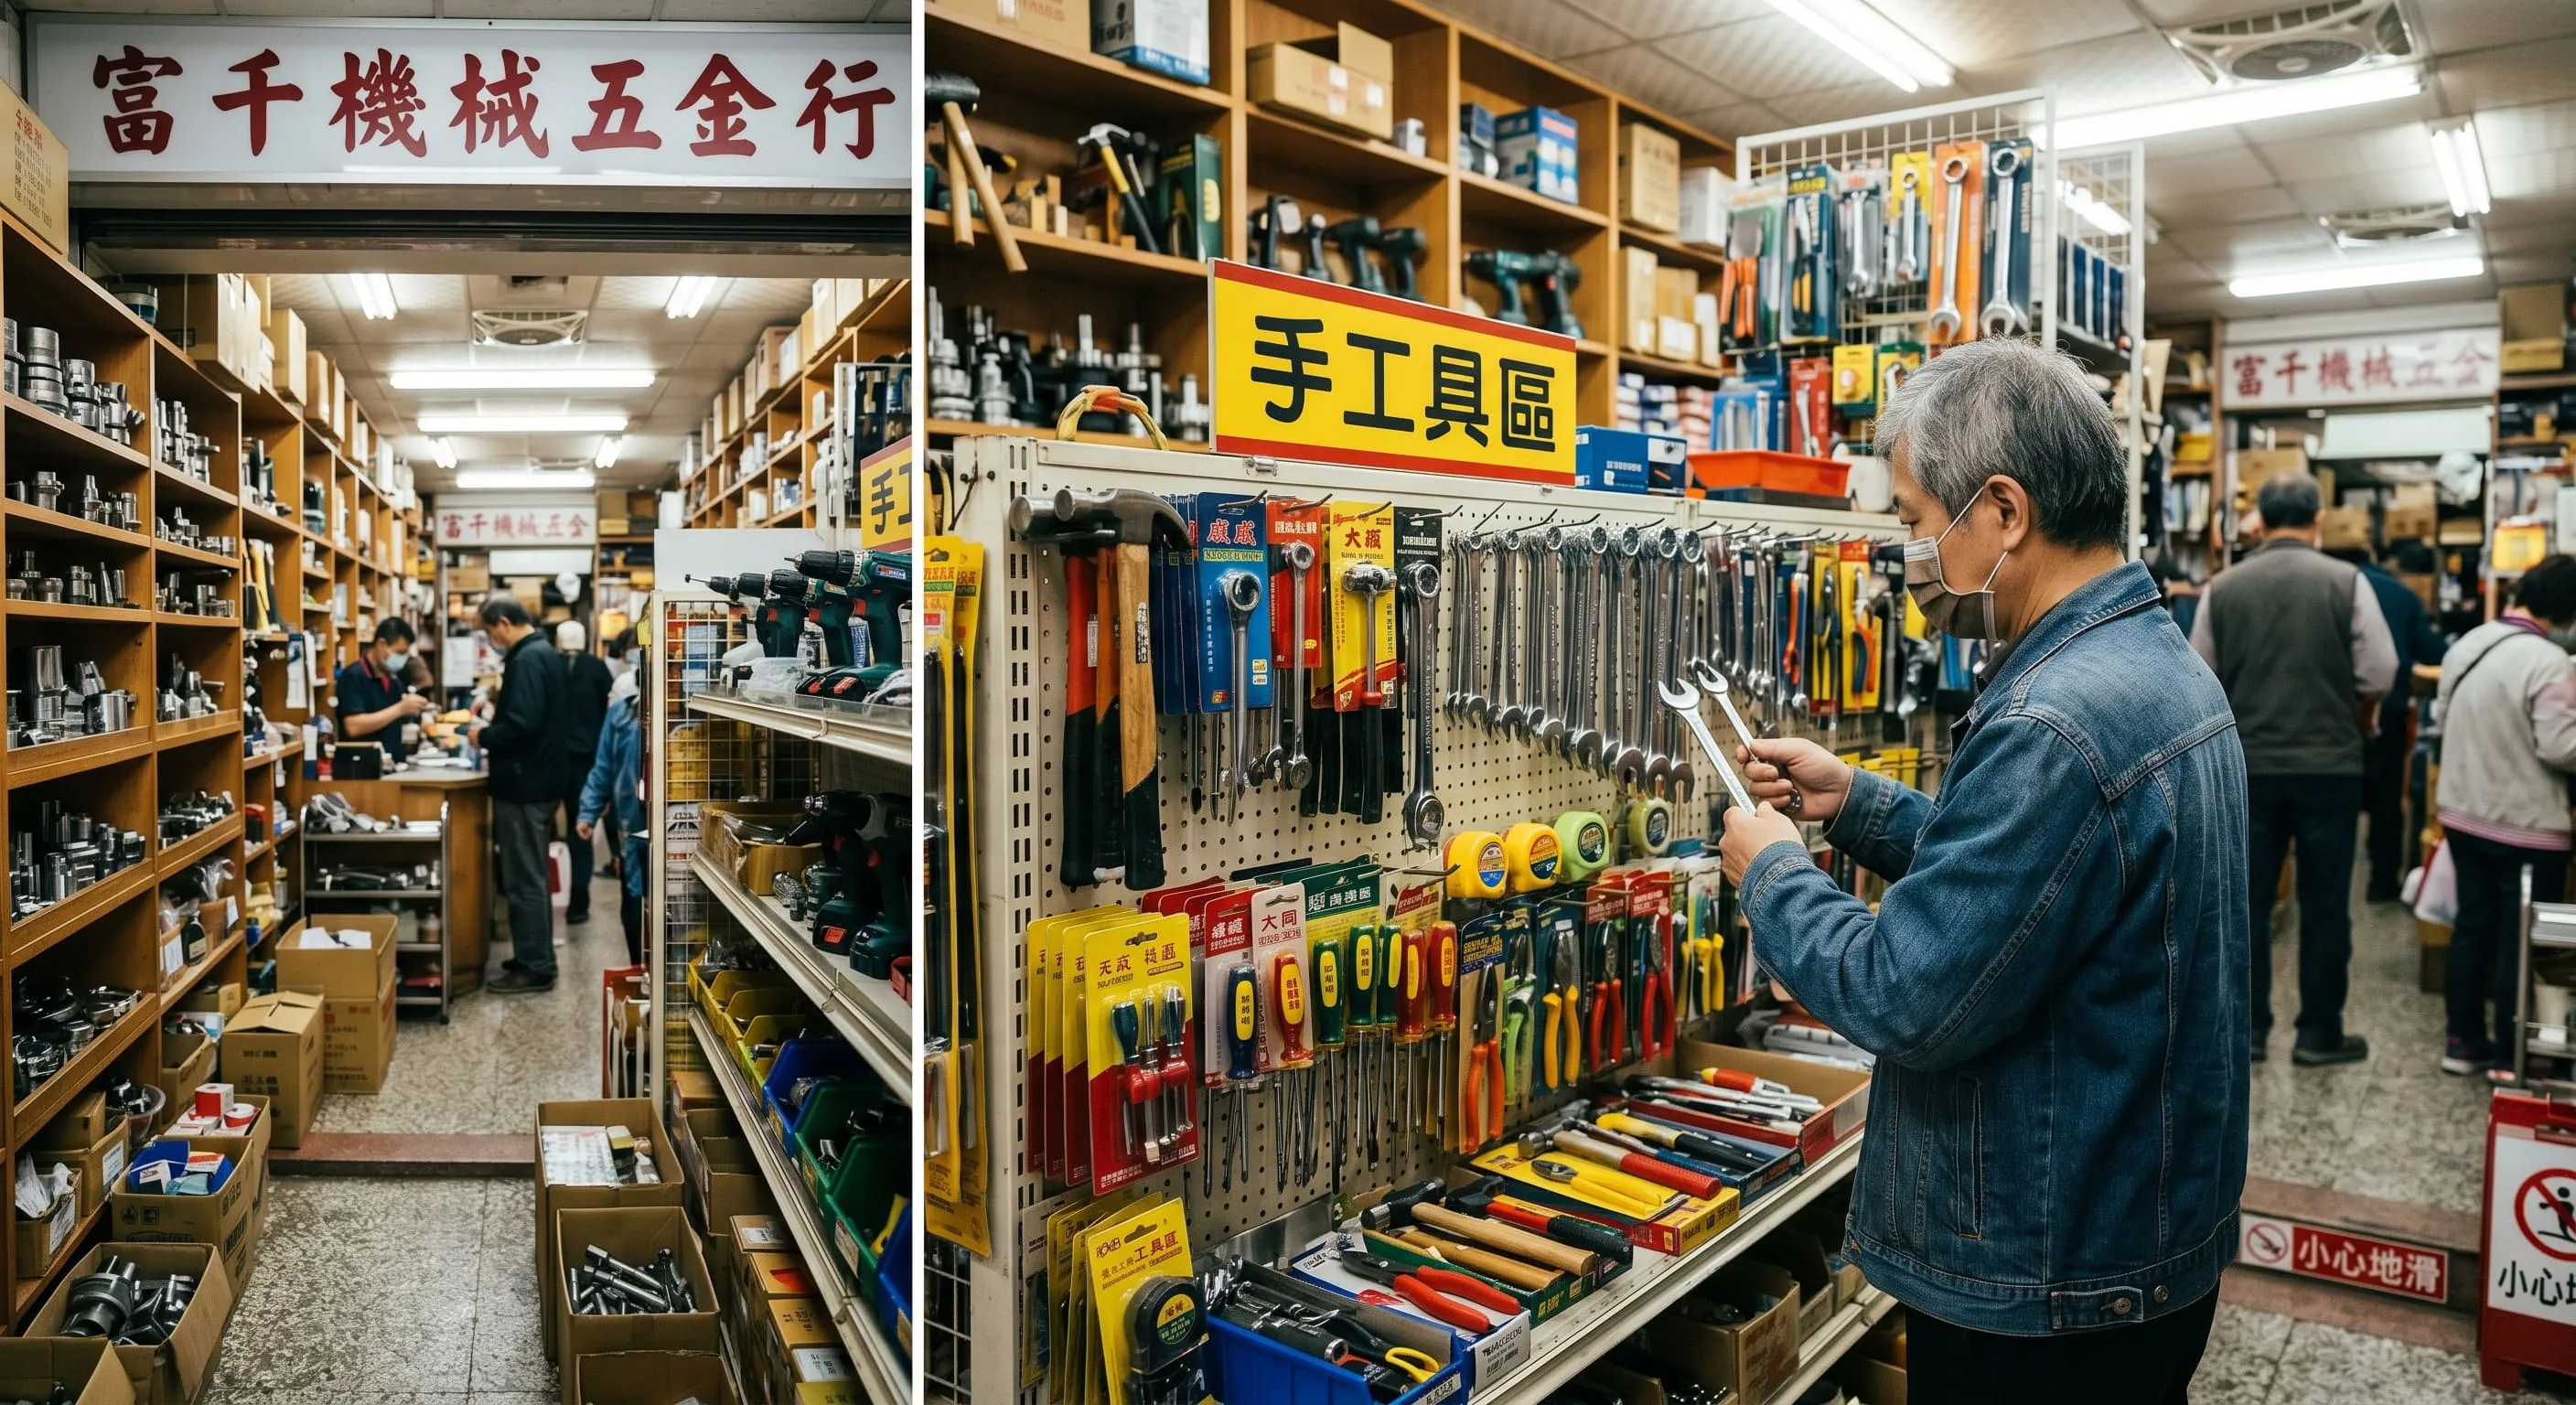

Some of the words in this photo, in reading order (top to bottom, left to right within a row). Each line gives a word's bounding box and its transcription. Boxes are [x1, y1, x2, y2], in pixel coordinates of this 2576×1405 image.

[92, 45, 896, 159] 富千機械五金行
[1250, 315, 1555, 452] 手工具區
[1261, 909, 1296, 932] 大同
[2298, 1234, 2440, 1293] 小心地滑
